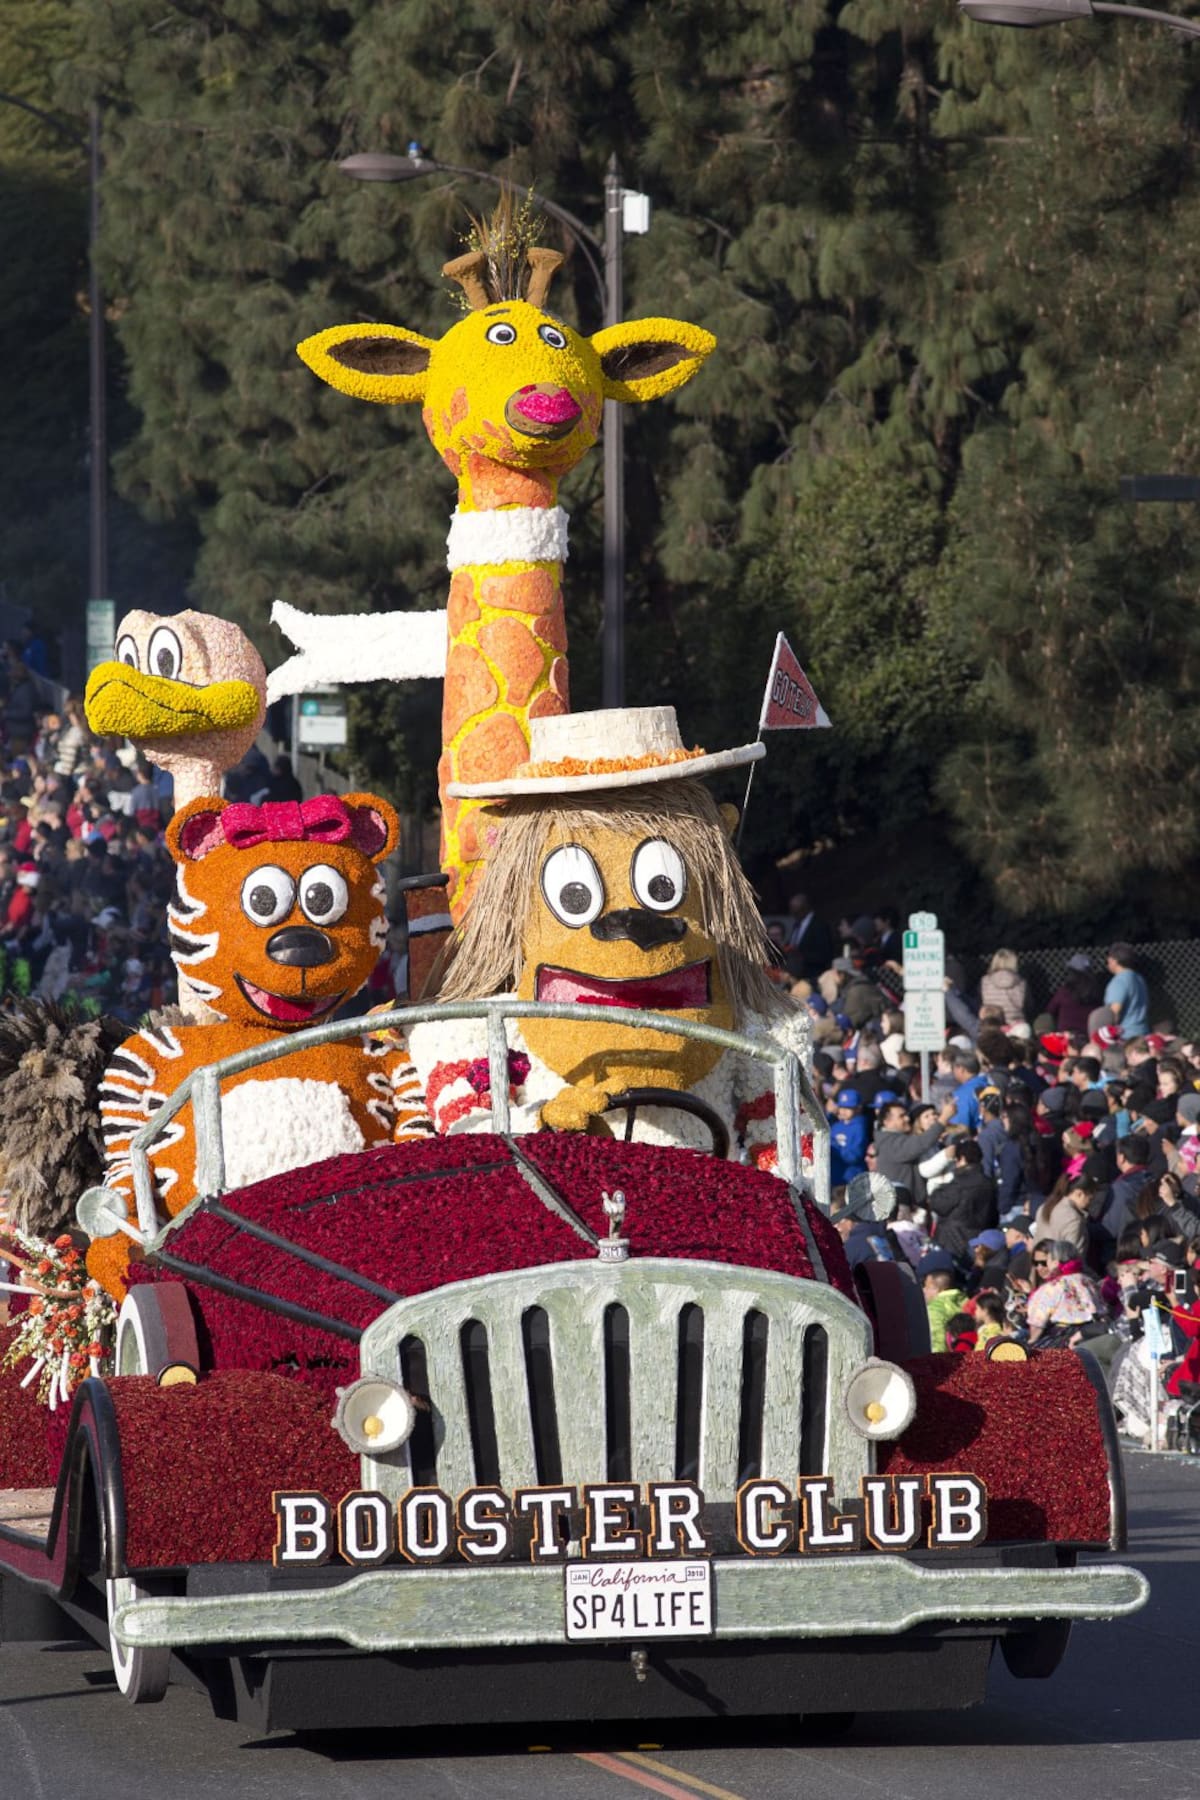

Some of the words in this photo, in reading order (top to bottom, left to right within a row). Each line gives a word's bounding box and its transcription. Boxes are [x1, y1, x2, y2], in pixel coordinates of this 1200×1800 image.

[272, 1480, 713, 1567] BOOSTER
[737, 1472, 987, 1555] CLUB
[572, 1573, 589, 1582] JAN
[590, 1567, 686, 1592] California
[572, 1591, 705, 1630] SP4LIFE
